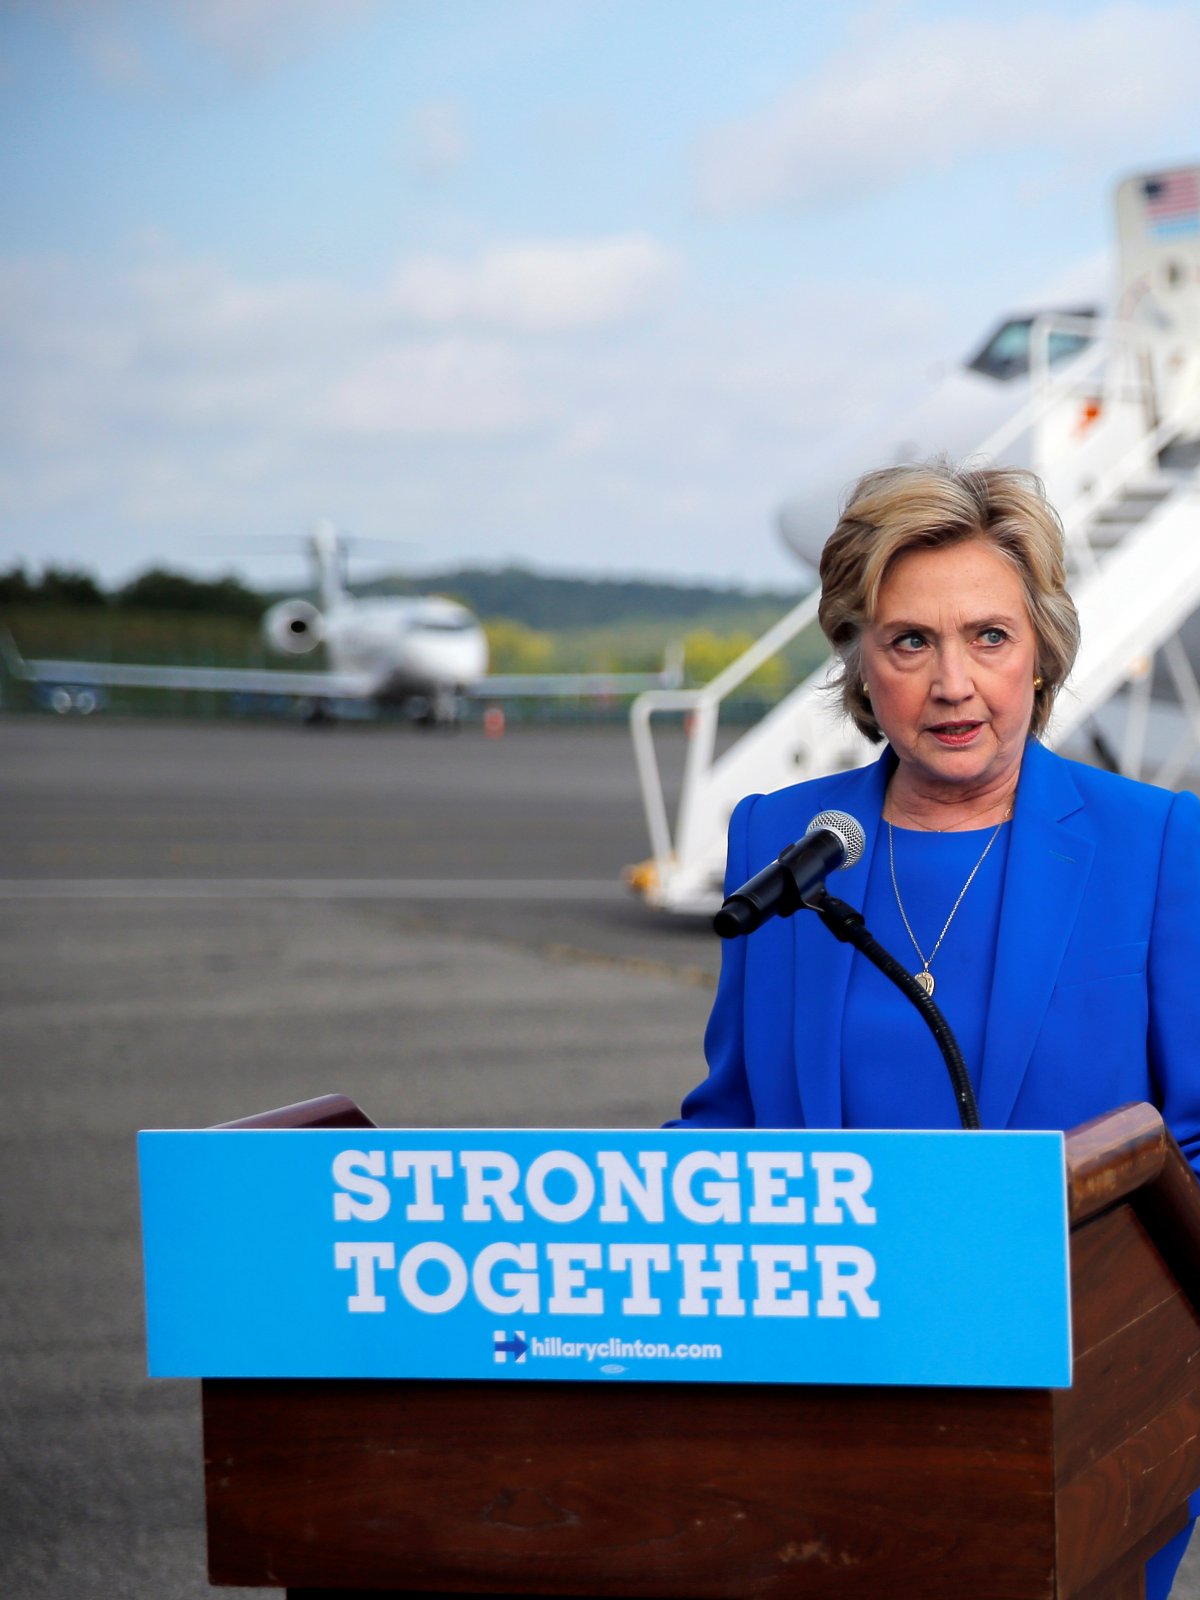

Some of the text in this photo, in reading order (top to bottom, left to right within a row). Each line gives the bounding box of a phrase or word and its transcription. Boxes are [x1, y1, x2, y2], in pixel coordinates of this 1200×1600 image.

[332, 1149, 877, 1225] STRONGER
[334, 1241, 880, 1318] TOGETHER
[531, 1337, 722, 1361] hillaryclinton.com
